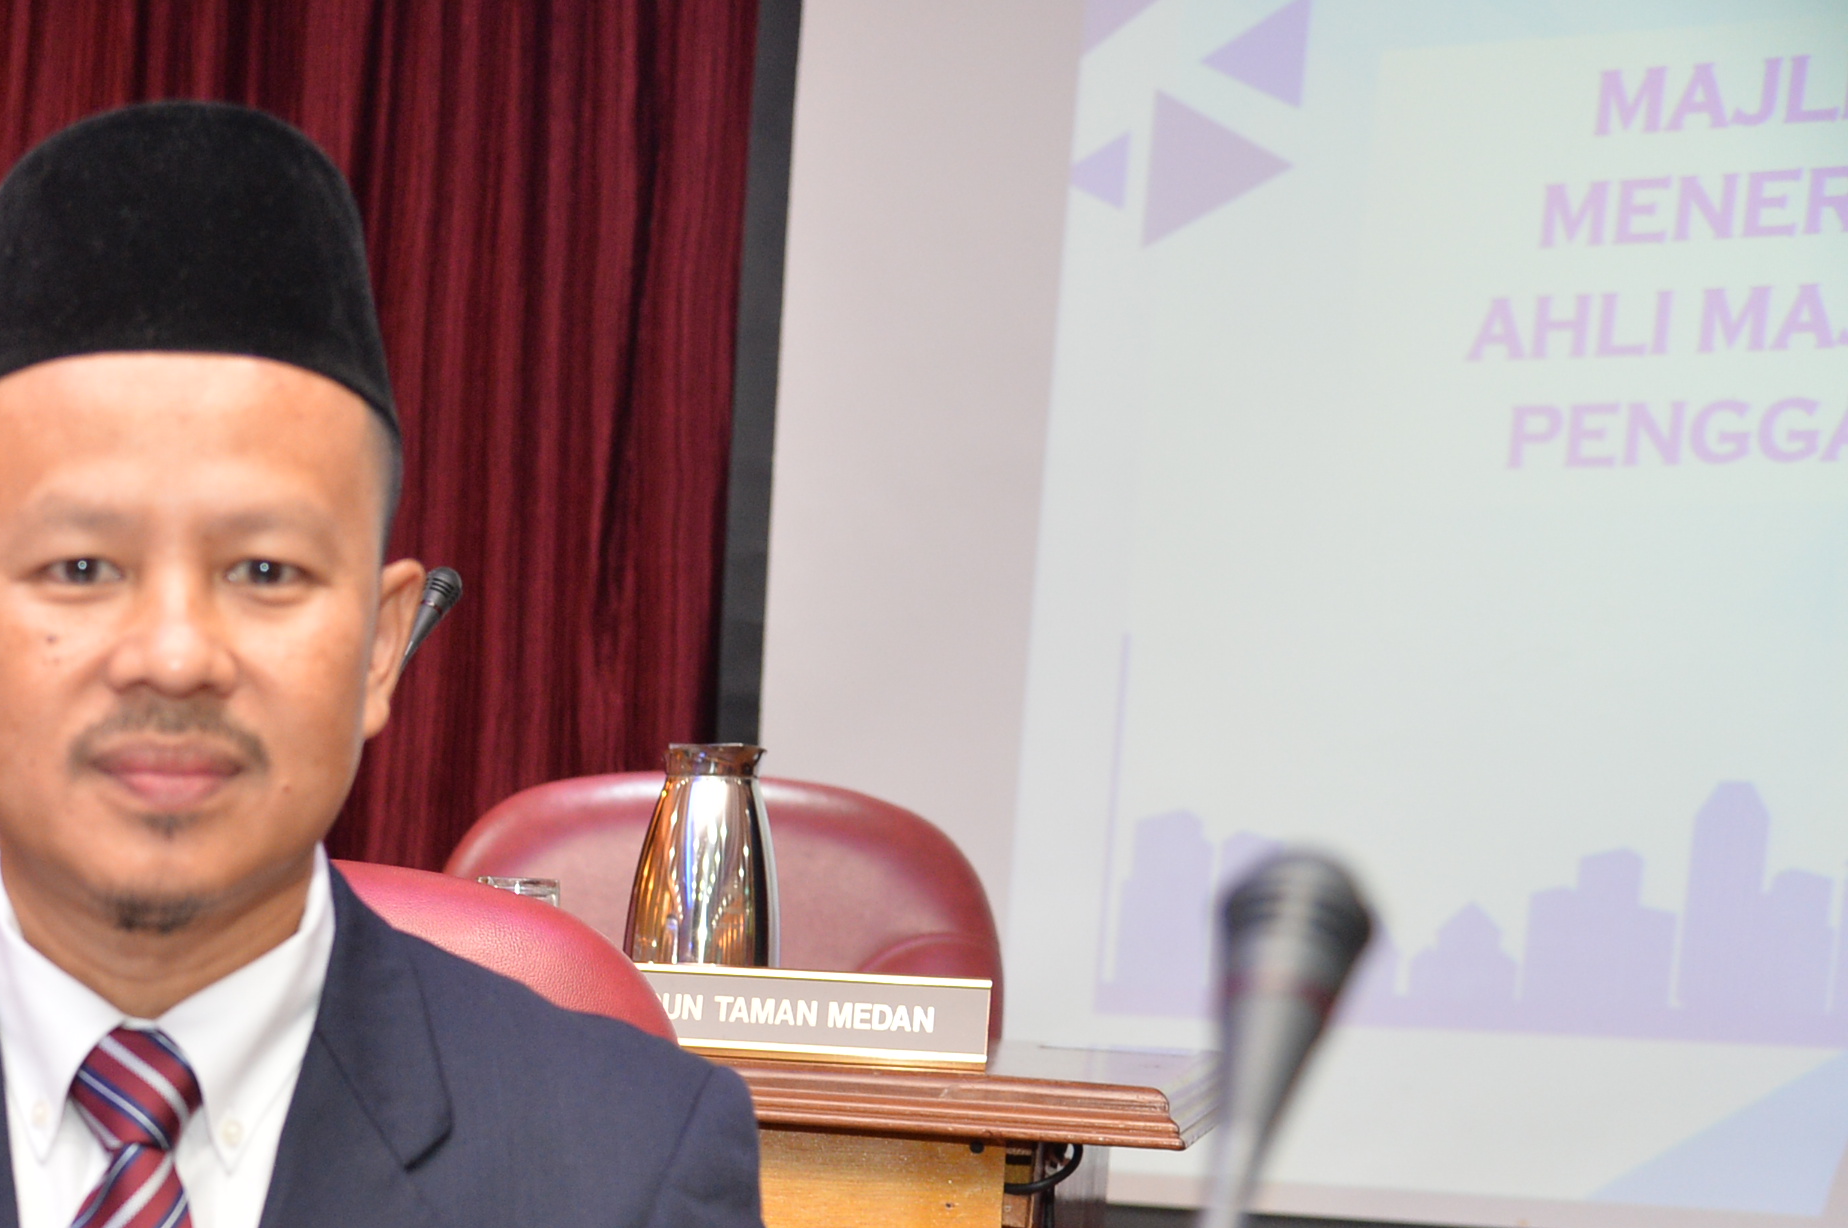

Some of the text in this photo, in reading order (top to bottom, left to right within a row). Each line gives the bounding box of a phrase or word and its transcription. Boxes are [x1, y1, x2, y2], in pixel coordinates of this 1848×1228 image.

[1593, 54, 1848, 137] MAJL
[1539, 165, 1848, 249] MENER
[1465, 282, 1848, 362] AHLI MA
[655, 992, 935, 1034] UN TAMAN MEDAN
